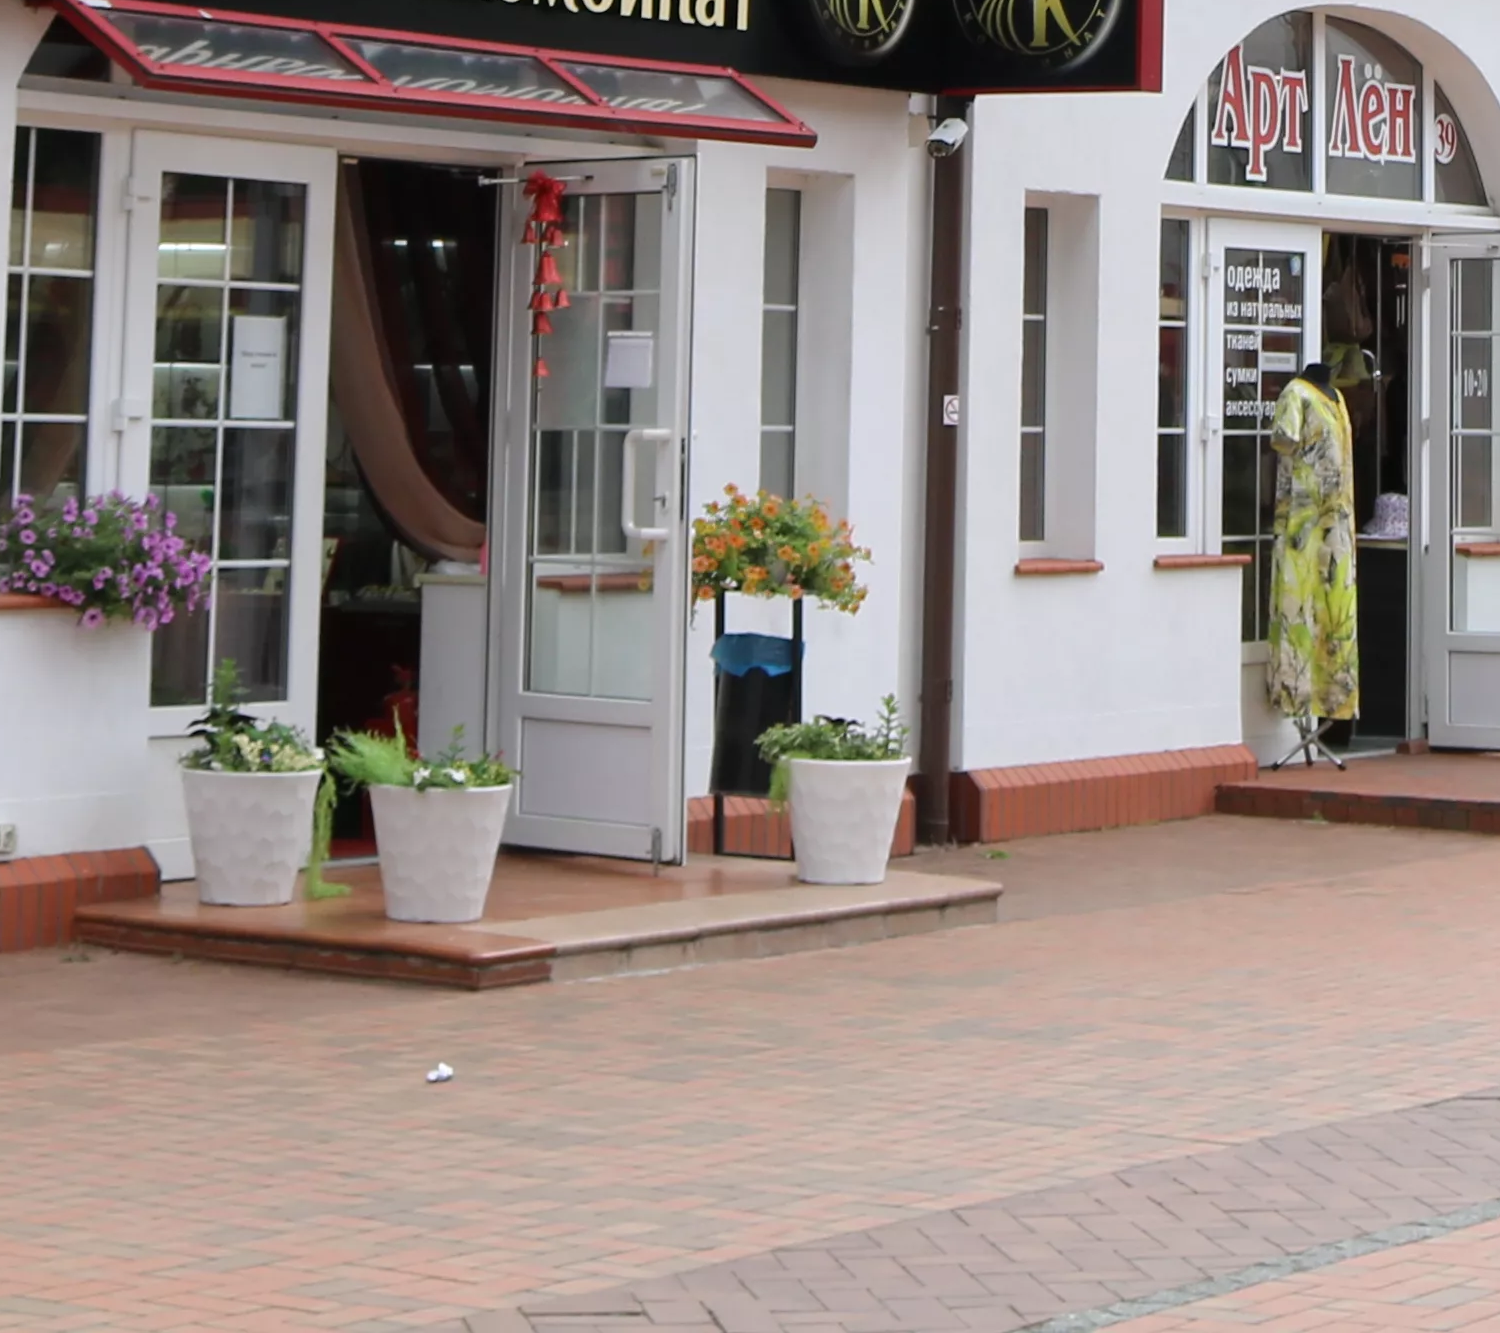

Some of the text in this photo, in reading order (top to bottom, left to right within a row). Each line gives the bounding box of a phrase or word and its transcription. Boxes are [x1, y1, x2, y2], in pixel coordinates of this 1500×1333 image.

[1211, 44, 1456, 183] Арт Лён 39
[1226, 264, 1281, 294] одежда
[1226, 300, 1239, 317] из
[1226, 329, 1260, 351] тканей
[1225, 366, 1258, 388] сумки
[1225, 399, 1277, 421] аксессуар
